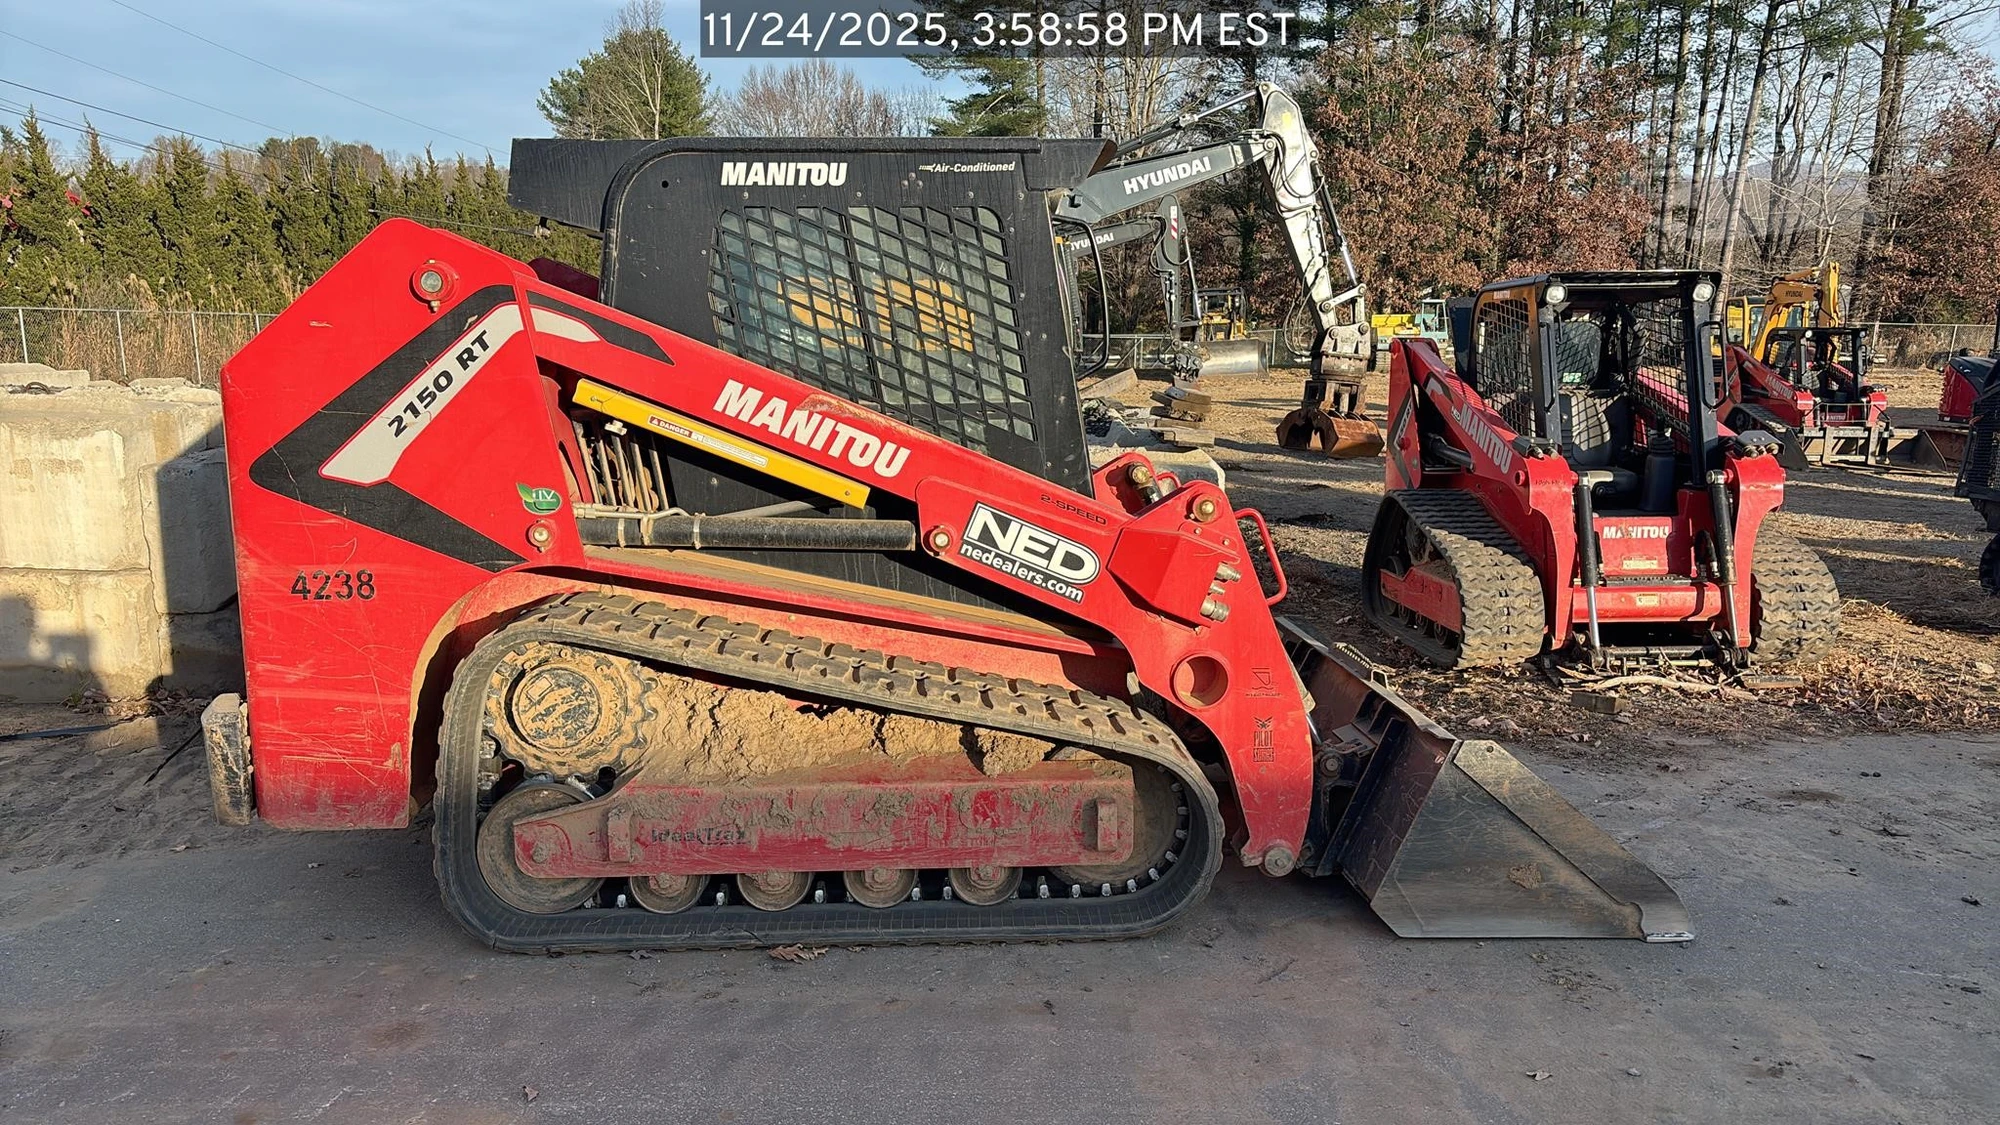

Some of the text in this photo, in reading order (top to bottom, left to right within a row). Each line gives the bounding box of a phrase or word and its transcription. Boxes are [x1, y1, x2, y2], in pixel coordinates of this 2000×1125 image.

[720, 161, 848, 187] MANITOU
[934, 161, 1016, 173] Air-Conditioned
[1122, 155, 1213, 196] HYUNDAI
[387, 329, 490, 438] 2150 RT
[659, 420, 691, 437] DANGER
[712, 378, 912, 478] MANITOU
[1460, 402, 1513, 475] MANITOU
[1040, 493, 1107, 525] 2-SPEED
[967, 506, 1097, 581] NED
[290, 568, 375, 600] 4238
[960, 543, 1084, 602] nedealers.com
[1253, 730, 1273, 747] PILOT
